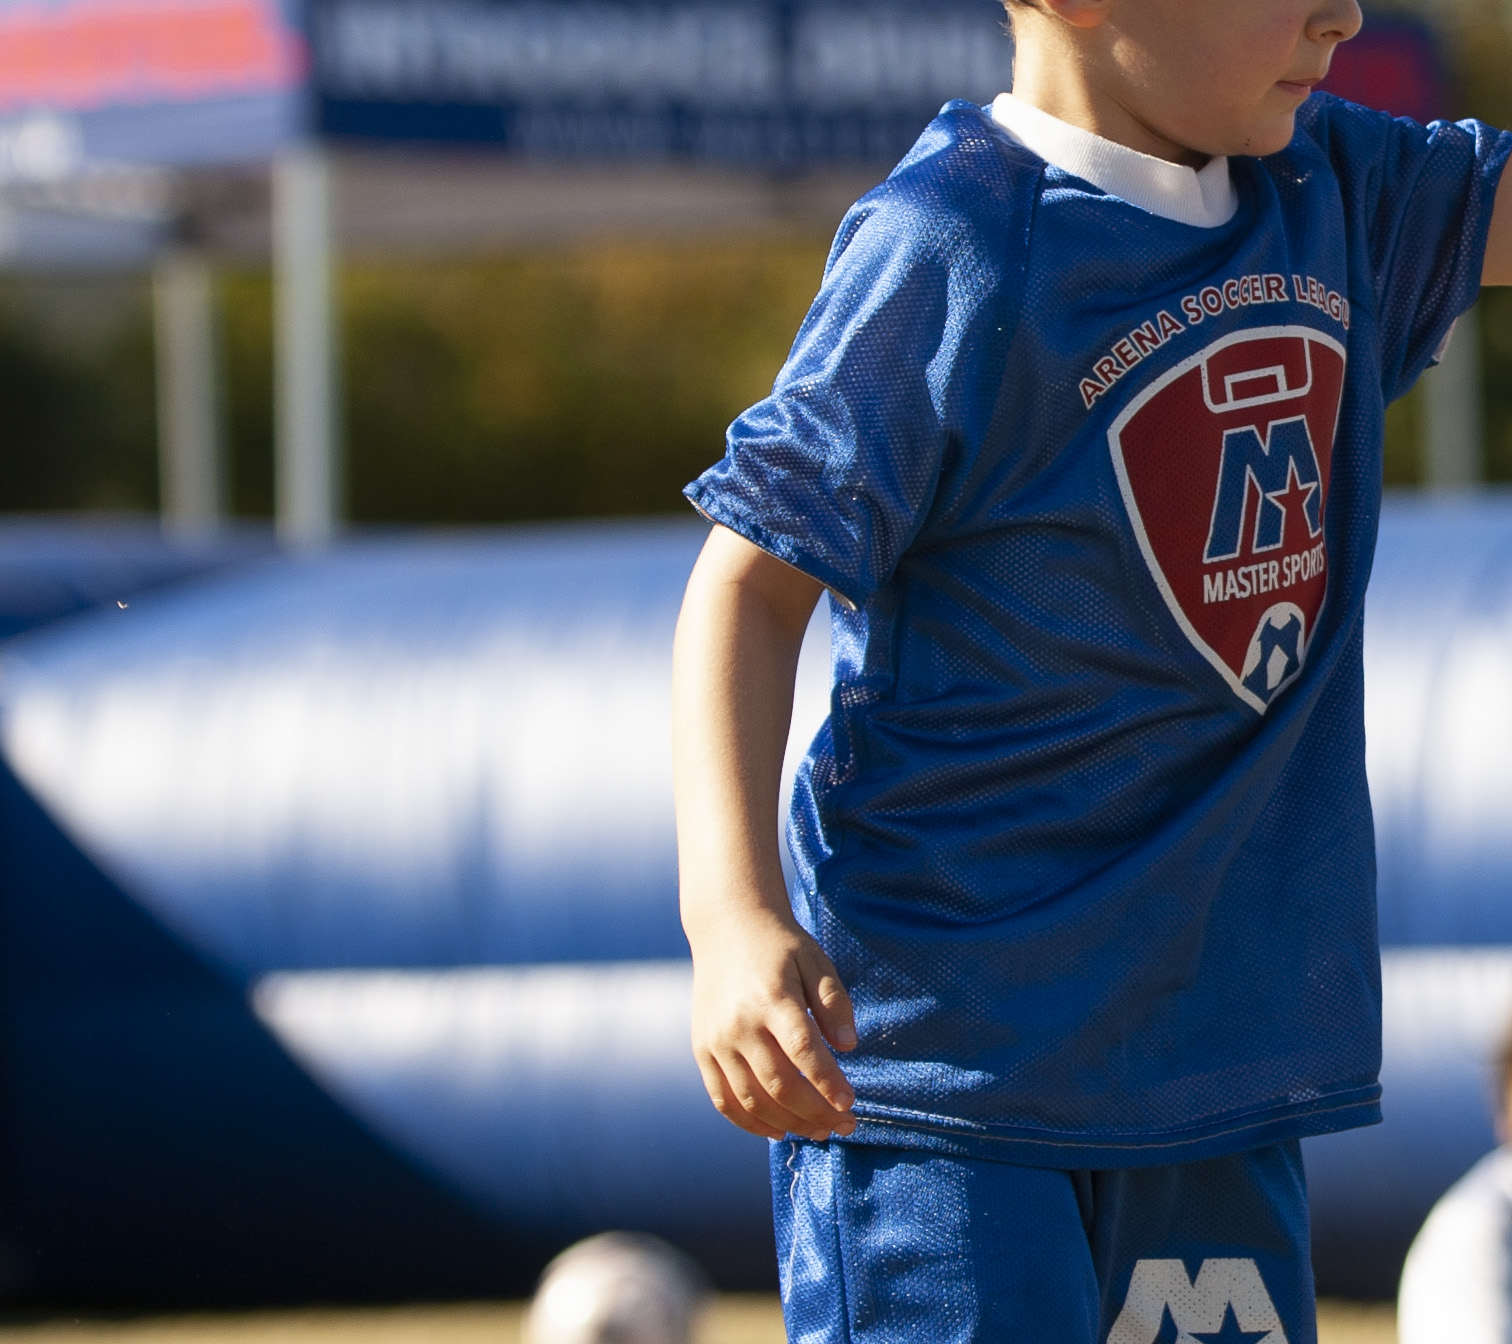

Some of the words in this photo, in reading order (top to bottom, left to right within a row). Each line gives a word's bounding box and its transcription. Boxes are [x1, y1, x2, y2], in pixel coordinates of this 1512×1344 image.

[1079, 310, 1186, 410] ARENA
[1181, 273, 1290, 325] SOCCER
[1202, 560, 1280, 605] MASTER
[1281, 541, 1325, 588] SPORTS
